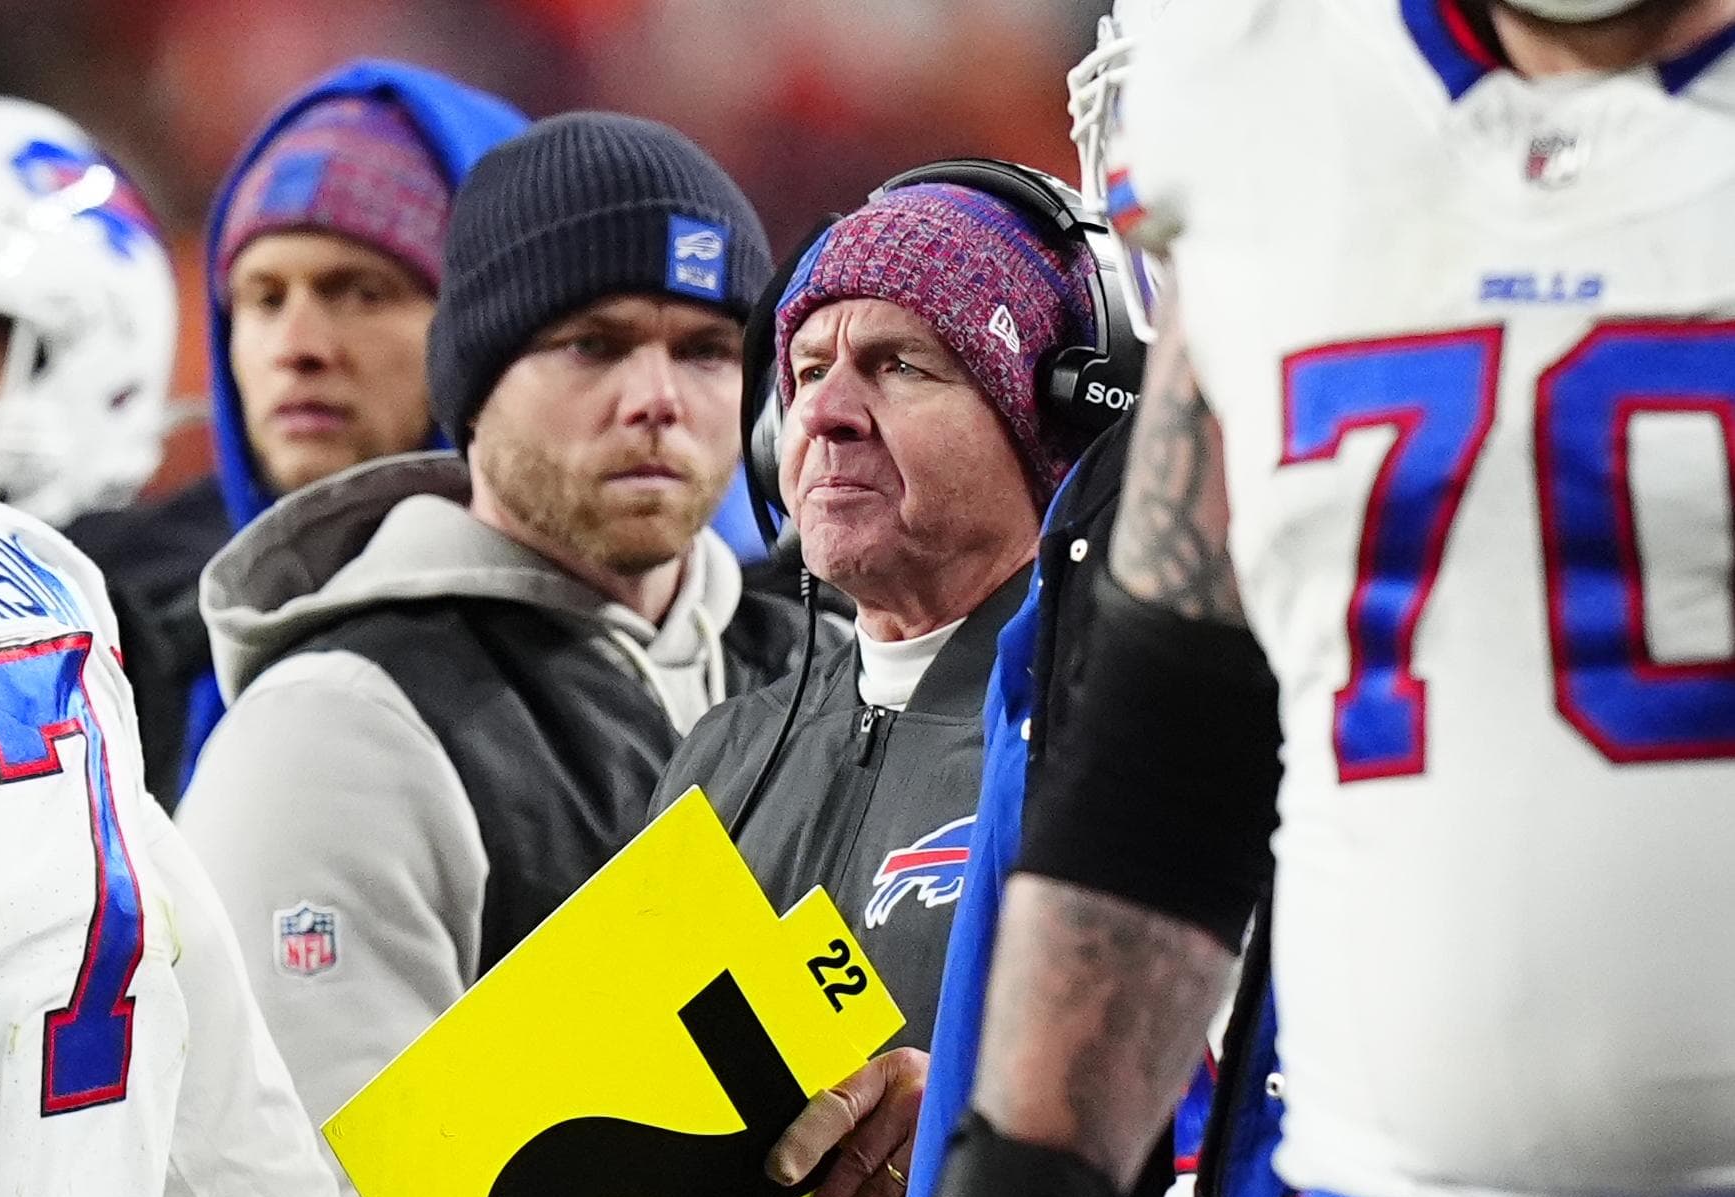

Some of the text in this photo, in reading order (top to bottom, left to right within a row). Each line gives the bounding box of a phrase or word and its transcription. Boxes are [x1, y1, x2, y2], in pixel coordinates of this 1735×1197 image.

[1085, 381, 1141, 411] SON
[1277, 317, 1735, 784] 70
[284, 935, 334, 971] NFL
[806, 938, 868, 1013] 22
